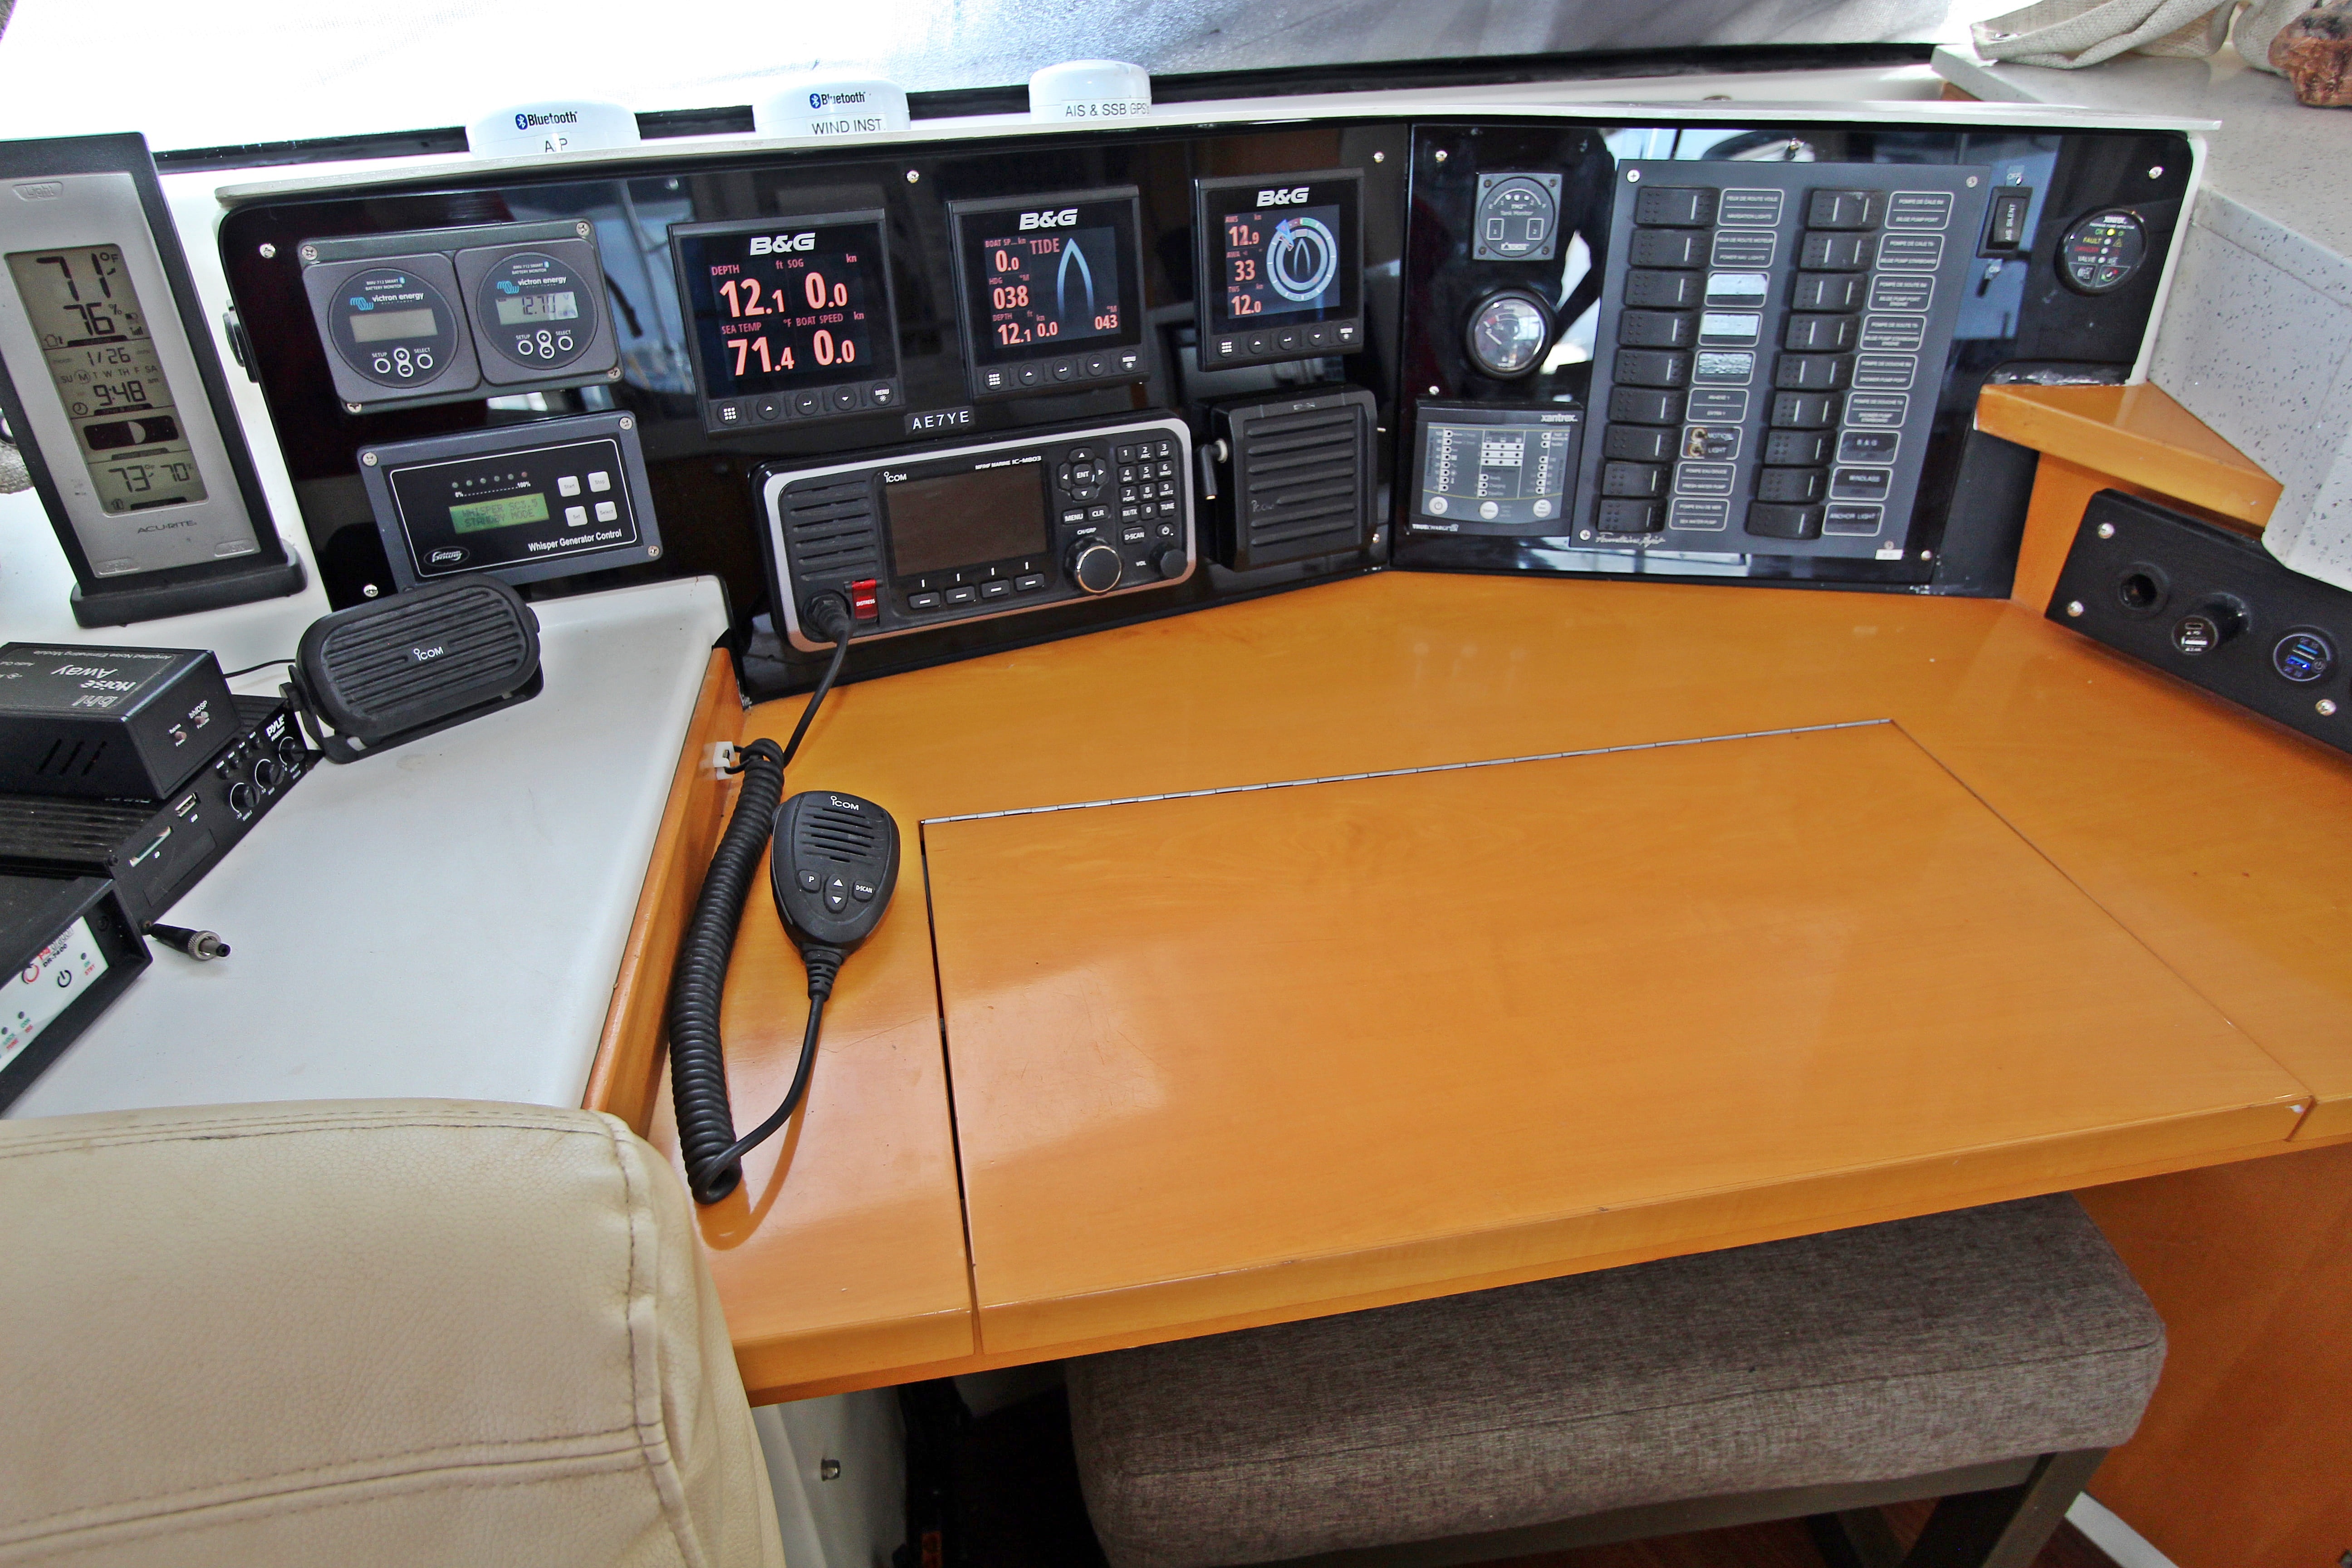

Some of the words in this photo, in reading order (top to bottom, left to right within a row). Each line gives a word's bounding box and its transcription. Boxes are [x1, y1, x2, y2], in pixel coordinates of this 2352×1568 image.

[527, 111, 578, 126] Bluetooth
[1066, 104, 1085, 117] AIS
[1090, 104, 1098, 116] &
[1102, 103, 1127, 116] SSB
[812, 121, 849, 134] WIND
[1257, 187, 1309, 207] B&G
[1019, 209, 1078, 230] B&G
[750, 233, 815, 256] B&G
[1229, 225, 1260, 246] 12.9
[1029, 238, 1060, 255] TIDE
[711, 265, 740, 275] DEPTH
[776, 260, 784, 269] ft
[788, 259, 804, 268] SOG
[846, 254, 857, 263] kn
[995, 250, 1019, 272] 0.0
[1235, 259, 1255, 281] 33
[36, 253, 111, 301] 71
[719, 278, 784, 318] 12.1
[805, 272, 848, 309] 0.0
[993, 285, 1029, 309] 038
[1231, 294, 1262, 315] 12.0
[63, 302, 115, 335] 76
[108, 303, 122, 315] %
[796, 316, 816, 326] BOAT
[819, 314, 843, 323] SPEED
[853, 311, 864, 320] kn
[993, 313, 1013, 321] DEPTH
[1094, 314, 1118, 330] 043
[722, 325, 736, 334] SEA
[738, 322, 761, 333] TEMP
[998, 323, 1031, 345] 12.1
[1037, 322, 1058, 337] 0.0
[728, 337, 794, 376] 71.4
[813, 329, 855, 366] 0.0
[60, 375, 73, 383] SU
[145, 365, 157, 373] SA
[93, 381, 146, 406] 9:48
[912, 411, 970, 430] AE7YE
[108, 466, 151, 493] 73
[161, 463, 190, 481] 70
[1076, 470, 1089, 479] ENT
[462, 503, 504, 517] WHISPER
[511, 508, 534, 519] MODE
[1161, 502, 1175, 510] TUNE
[1064, 513, 1083, 522] MENU
[528, 541, 558, 552] Whisper
[559, 534, 594, 547] Generator
[596, 529, 622, 541] Control
[1124, 532, 1145, 540] D-SCAN
[856, 598, 875, 607] DISTRESS
[51, 665, 118, 679] Away
[80, 680, 137, 692] Noise
[266, 713, 285, 737] PYLE
[856, 885, 872, 894] D-SCAN
[43, 943, 68, 967] DR-7400
